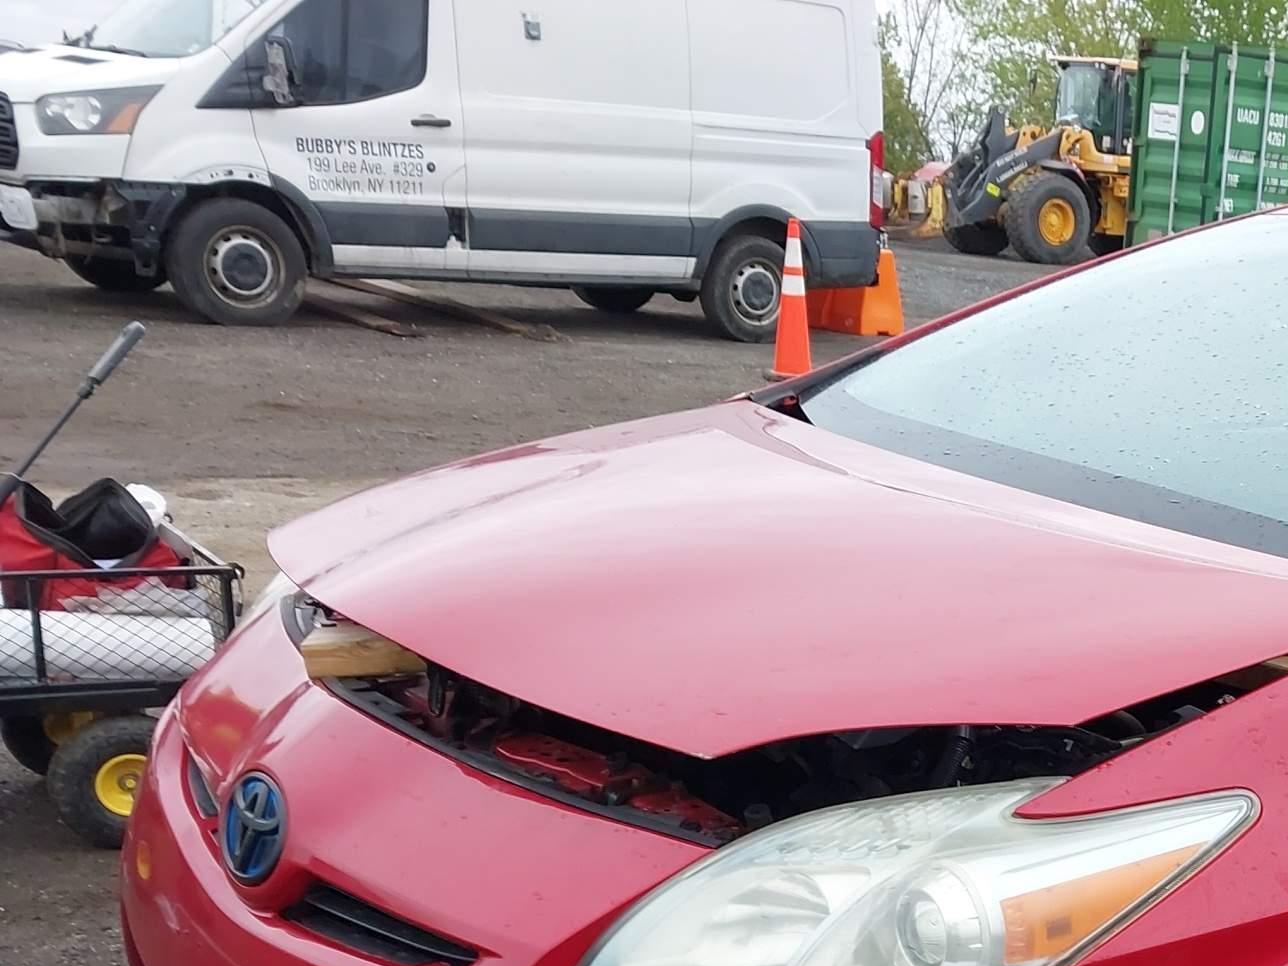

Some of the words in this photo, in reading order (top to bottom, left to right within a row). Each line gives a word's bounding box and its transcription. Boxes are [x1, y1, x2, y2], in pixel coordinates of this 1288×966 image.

[295, 137, 357, 155] BUBBY'S
[360, 140, 425, 159] BLINTZES
[307, 157, 331, 172] 199
[334, 158, 357, 174] Lee
[360, 159, 387, 176] Ave.
[393, 162, 424, 177] #329
[308, 175, 364, 195] Brooklyn,
[367, 179, 384, 193] NY
[389, 180, 424, 195] 11211
